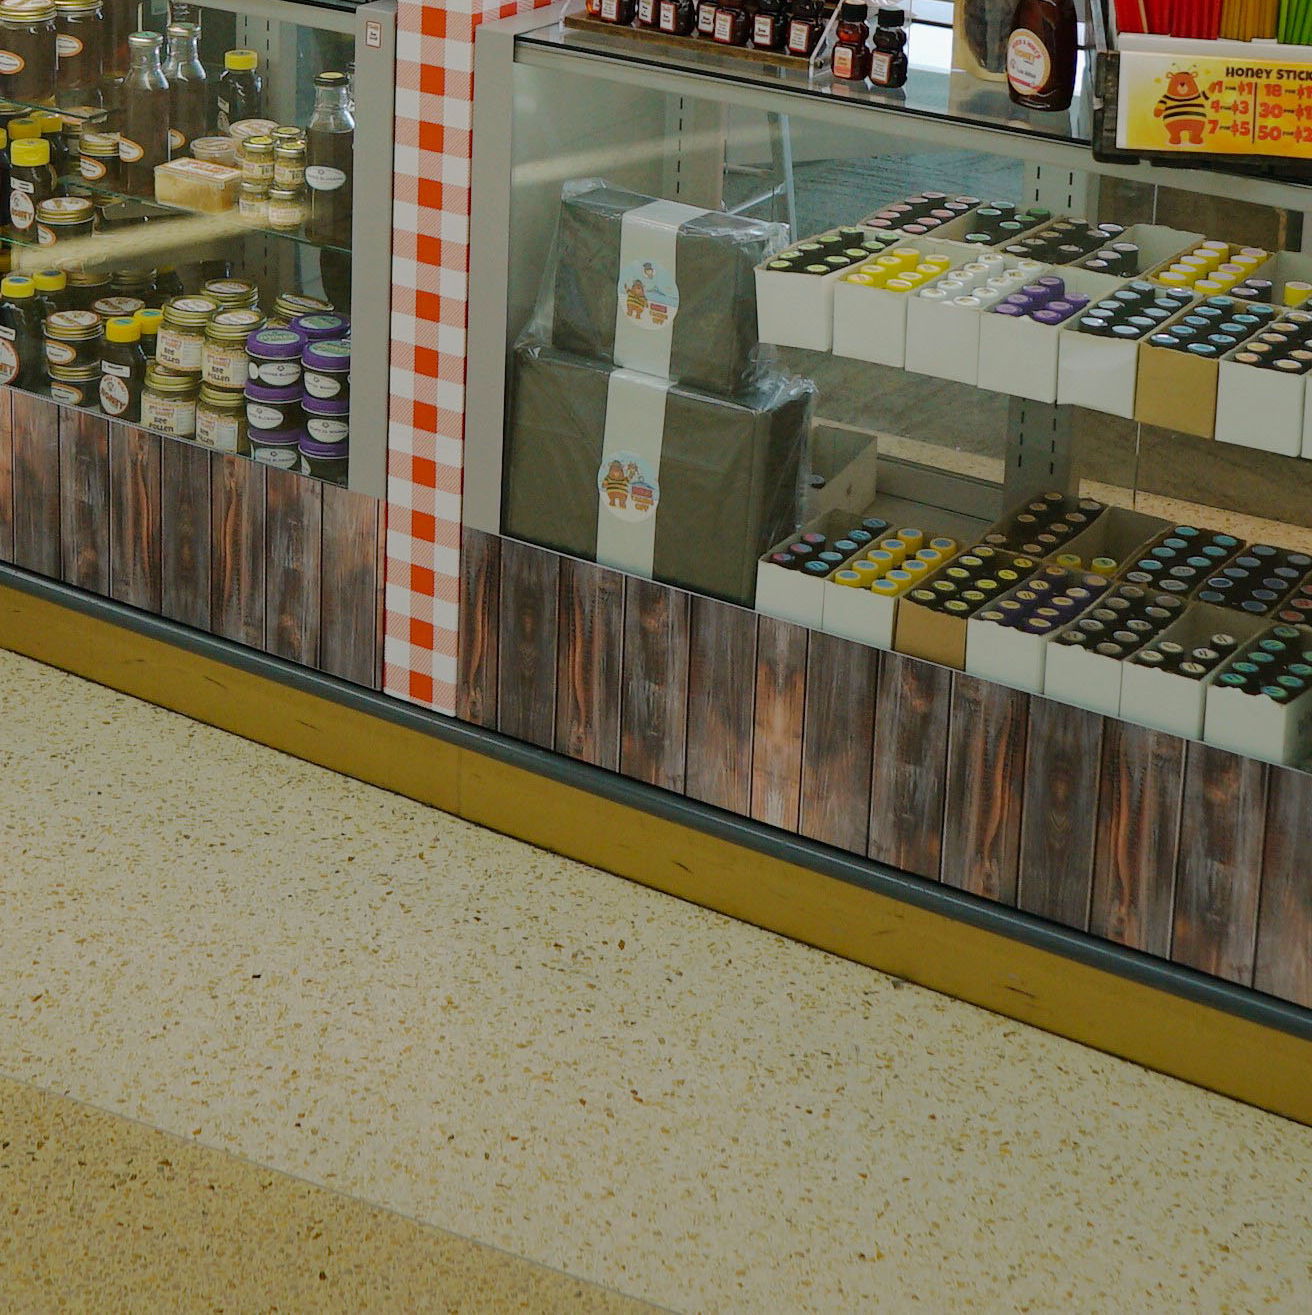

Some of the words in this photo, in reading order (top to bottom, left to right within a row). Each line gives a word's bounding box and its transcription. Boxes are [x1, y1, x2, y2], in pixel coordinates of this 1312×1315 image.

[1231, 99, 1249, 116] $3
[1259, 102, 1284, 119] 30
[1208, 119, 1219, 134] 7
[1231, 119, 1250, 137] $5
[1257, 125, 1281, 141] 50
